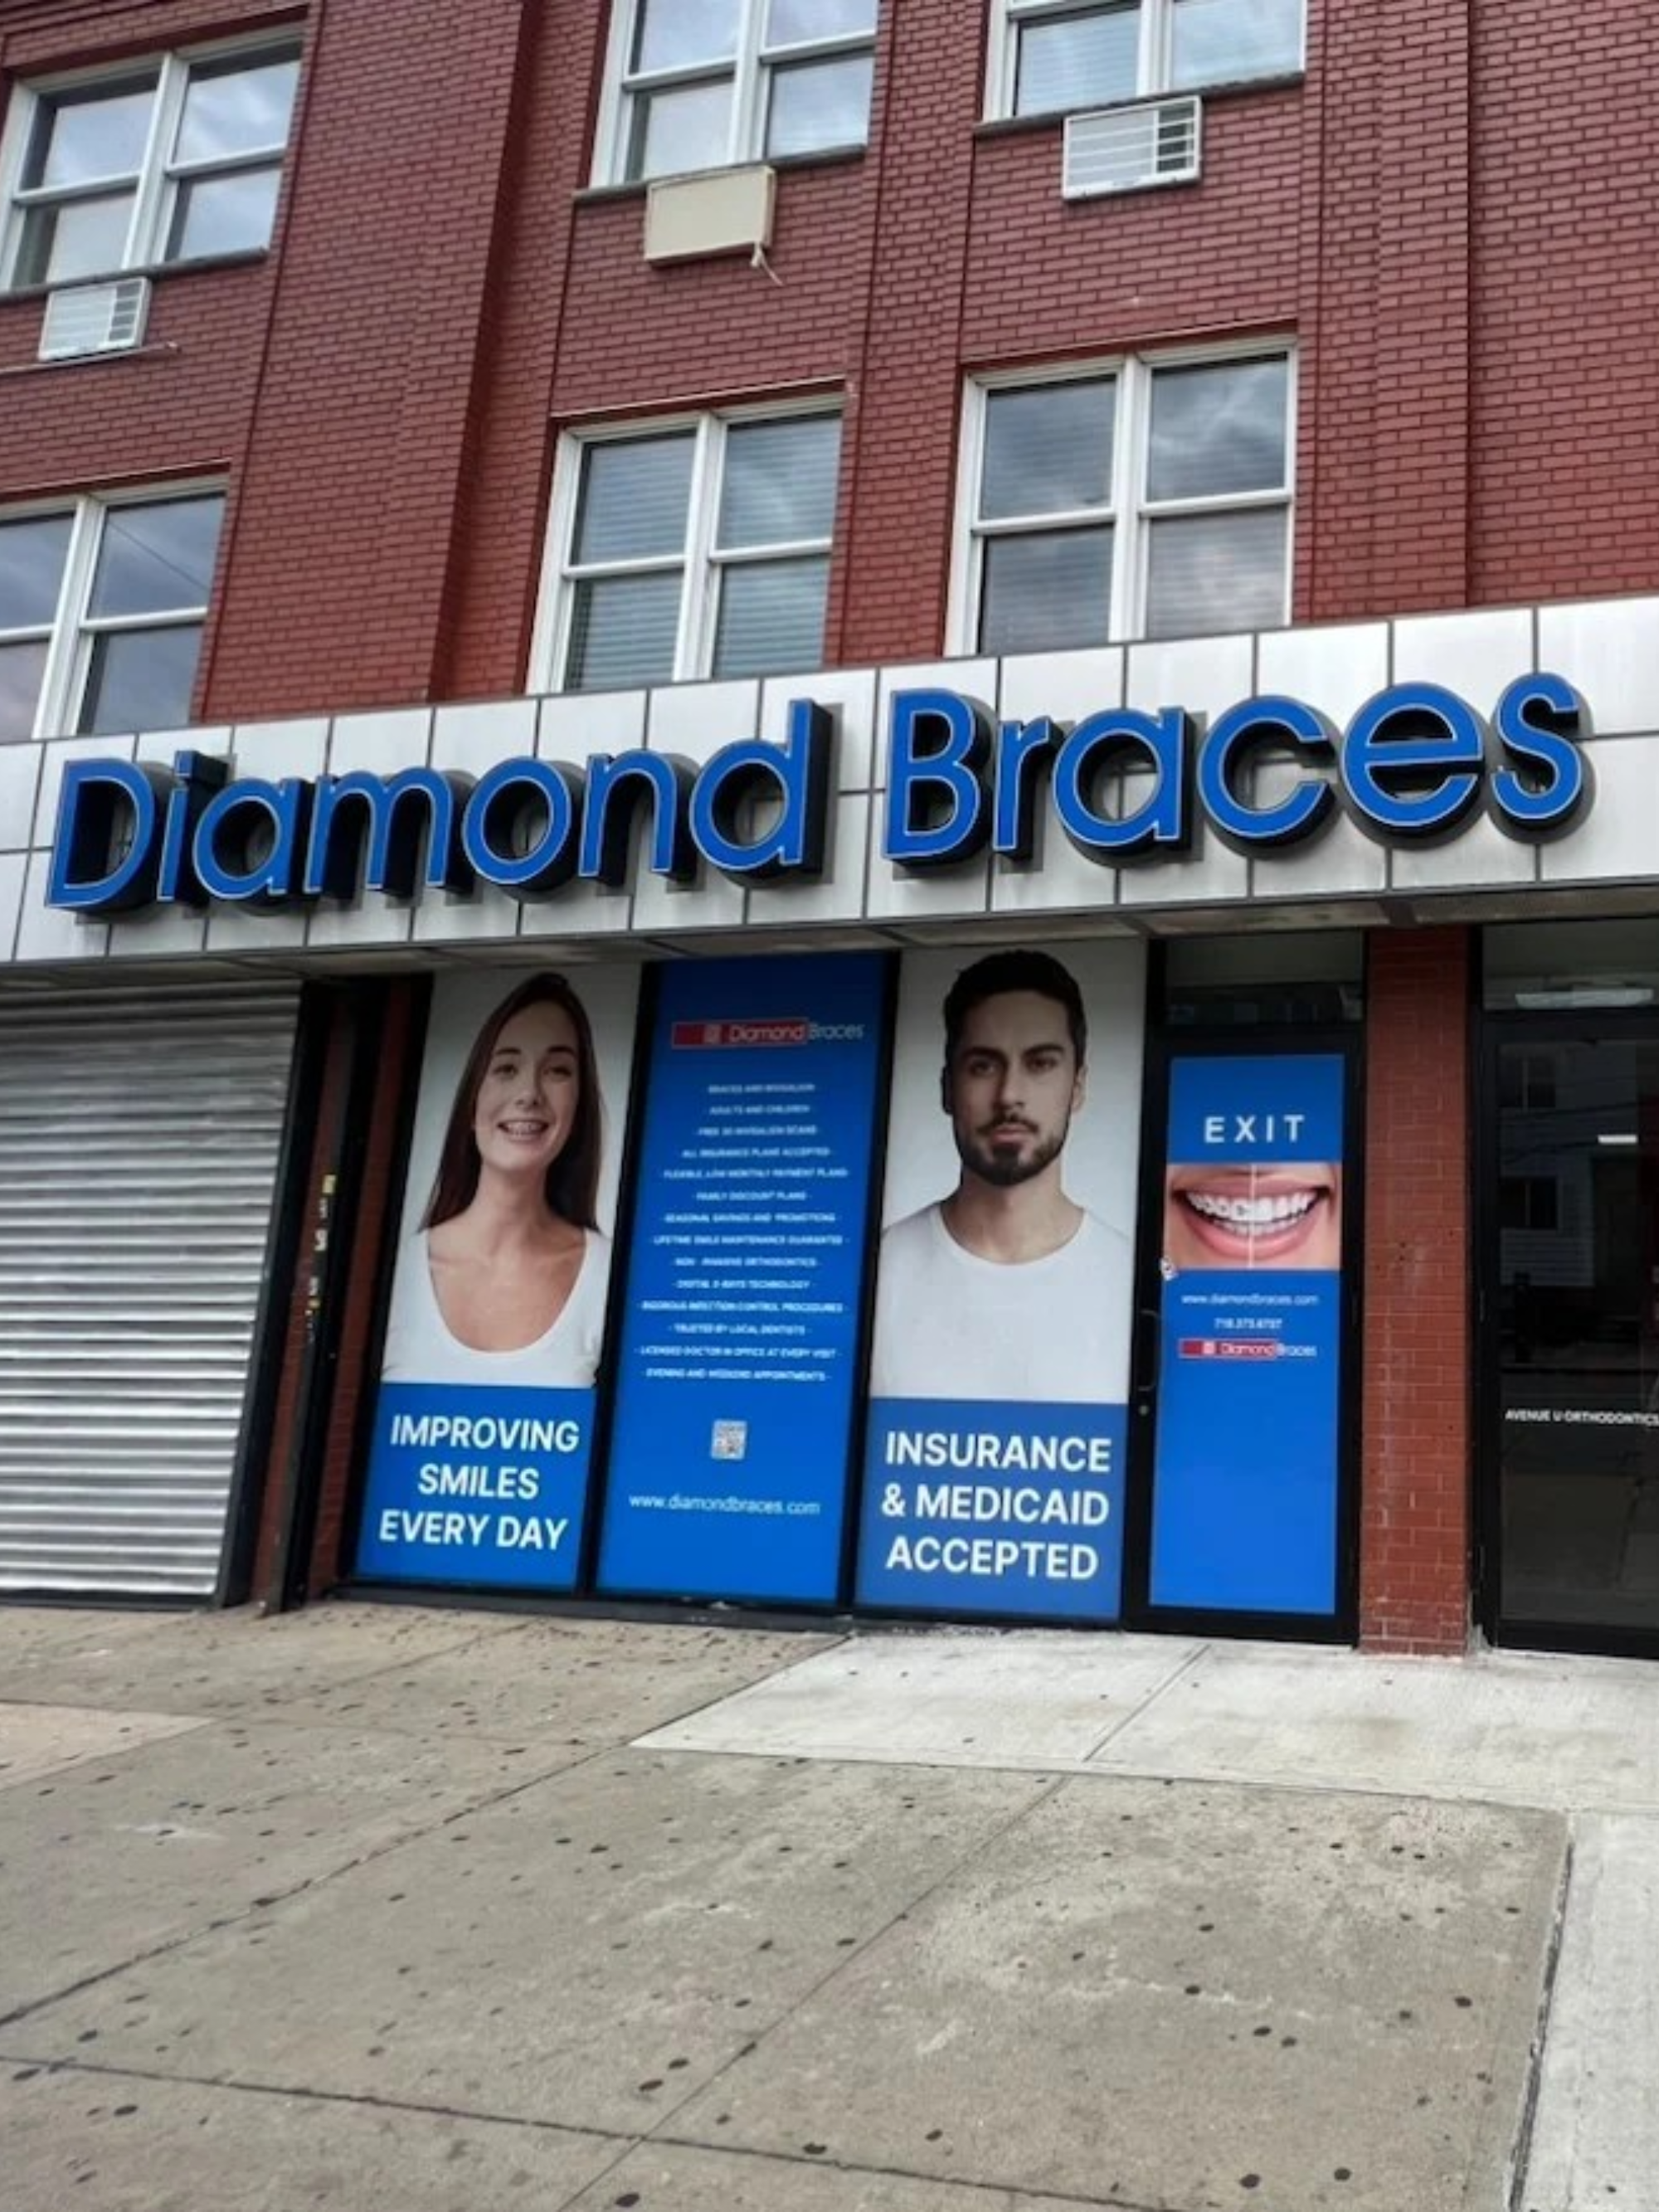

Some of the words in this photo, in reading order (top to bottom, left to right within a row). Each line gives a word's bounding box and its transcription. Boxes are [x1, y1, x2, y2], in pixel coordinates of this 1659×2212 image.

[45, 698, 833, 910] Diamond
[884, 672, 1586, 863] Braces
[1203, 1115, 1306, 1144] EXIT
[390, 1414, 580, 1452] IMPROVING
[884, 1431, 1112, 1472] INSURANCE
[417, 1462, 540, 1500] SMILES
[881, 1483, 906, 1517] &
[915, 1484, 1110, 1525] MEDICAID
[379, 1508, 489, 1546] EVERY
[496, 1515, 567, 1550] DAY
[885, 1535, 1099, 1580] ACCEPTED
